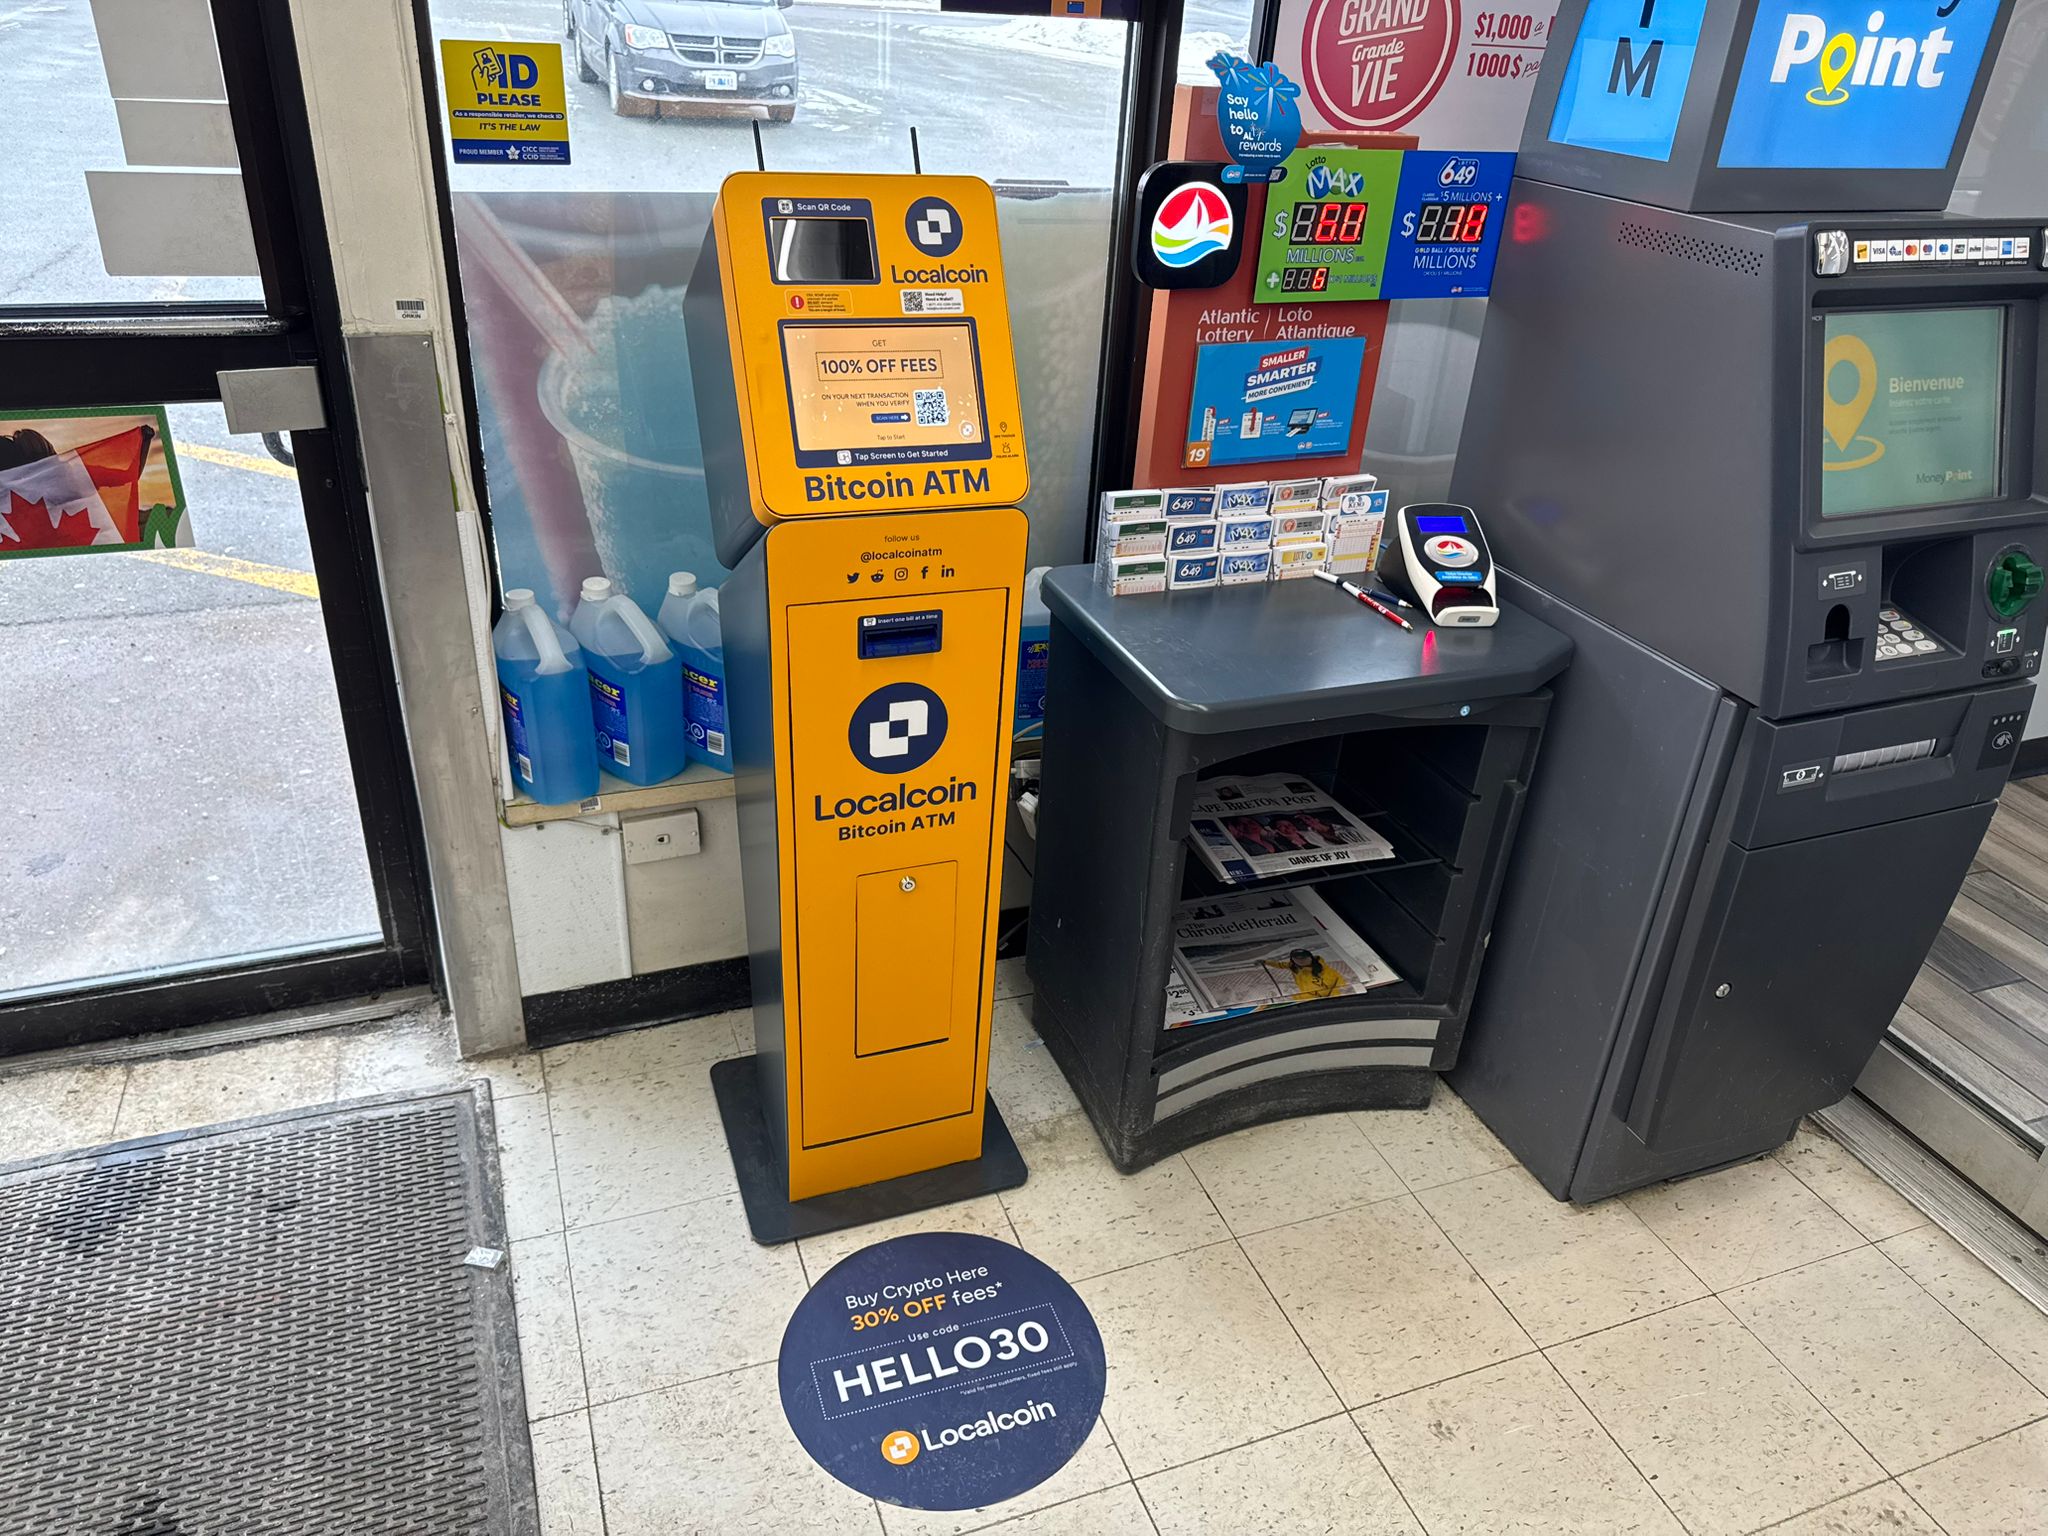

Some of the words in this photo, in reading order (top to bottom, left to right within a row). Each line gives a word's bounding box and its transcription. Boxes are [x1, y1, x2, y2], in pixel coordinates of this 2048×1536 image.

[1339, 0, 1429, 37] GRAND
[1474, 12, 1533, 42] $1,000
[1352, 38, 1405, 63] Grande
[1770, 11, 1954, 105] Point
[496, 53, 538, 89] ID
[1521, 61, 1540, 79] pa
[1350, 56, 1403, 107] VIE
[477, 92, 541, 107] PLEASE
[1227, 94, 1248, 107] Say
[468, 111, 503, 119] responsible
[1229, 107, 1258, 120] hello
[479, 122, 496, 130] IT'S
[498, 123, 517, 131] THE
[519, 123, 541, 131] LAW
[1230, 123, 1243, 135] to
[1243, 131, 1254, 141] AL
[479, 148, 504, 156] MEMBER
[1239, 138, 1282, 152] rewards
[1306, 156, 1327, 170] Lotto
[1307, 165, 1362, 198] MAX
[796, 203, 818, 211] Scan
[818, 204, 830, 212] QR
[830, 203, 852, 212] Code
[890, 263, 989, 284] Localcoin
[1199, 308, 1260, 325] Atlantic
[1278, 307, 1313, 323] Loto
[1196, 328, 1254, 343] Lottery
[1276, 324, 1356, 340] Atlantique
[872, 339, 887, 348] GET
[820, 359, 863, 375] 100%
[866, 358, 897, 373] OFF
[900, 357, 938, 373] FEES
[1262, 349, 1306, 368] SMALLER
[1246, 361, 1317, 387] SMARTER
[1247, 389, 1268, 399] MORE
[1268, 379, 1313, 395] CONVENIENT
[1889, 376, 1965, 393] Bienvenue
[854, 453, 868, 462] Tap
[870, 451, 897, 461] Screen
[897, 451, 906, 459] to
[906, 450, 921, 459] Get
[921, 449, 949, 458] Started
[804, 471, 914, 502] Bitcoin
[923, 467, 990, 496] ATM
[884, 534, 908, 543] follow
[910, 534, 920, 542] us
[860, 547, 943, 563] @localcoinatm
[815, 776, 977, 821] Localcoin
[1223, 797, 1279, 811] BRETON
[1281, 793, 1318, 806] POST
[838, 819, 906, 841] Bitcoin
[911, 811, 955, 831] ATM
[1288, 853, 1319, 865] DANCE
[1319, 852, 1332, 862] OF
[1335, 850, 1351, 861] JOY
[845, 1292, 879, 1310] Buy
[882, 1276, 944, 1299] Crypto
[946, 1266, 989, 1285] Here
[850, 1305, 900, 1331] 30%
[903, 1293, 947, 1318] OFF
[908, 1330, 930, 1343] Use
[932, 1323, 960, 1337] code
[832, 1320, 1049, 1404] HELLO30
[1027, 1370, 1041, 1378] fixed
[920, 1399, 1057, 1451] Localcoin
